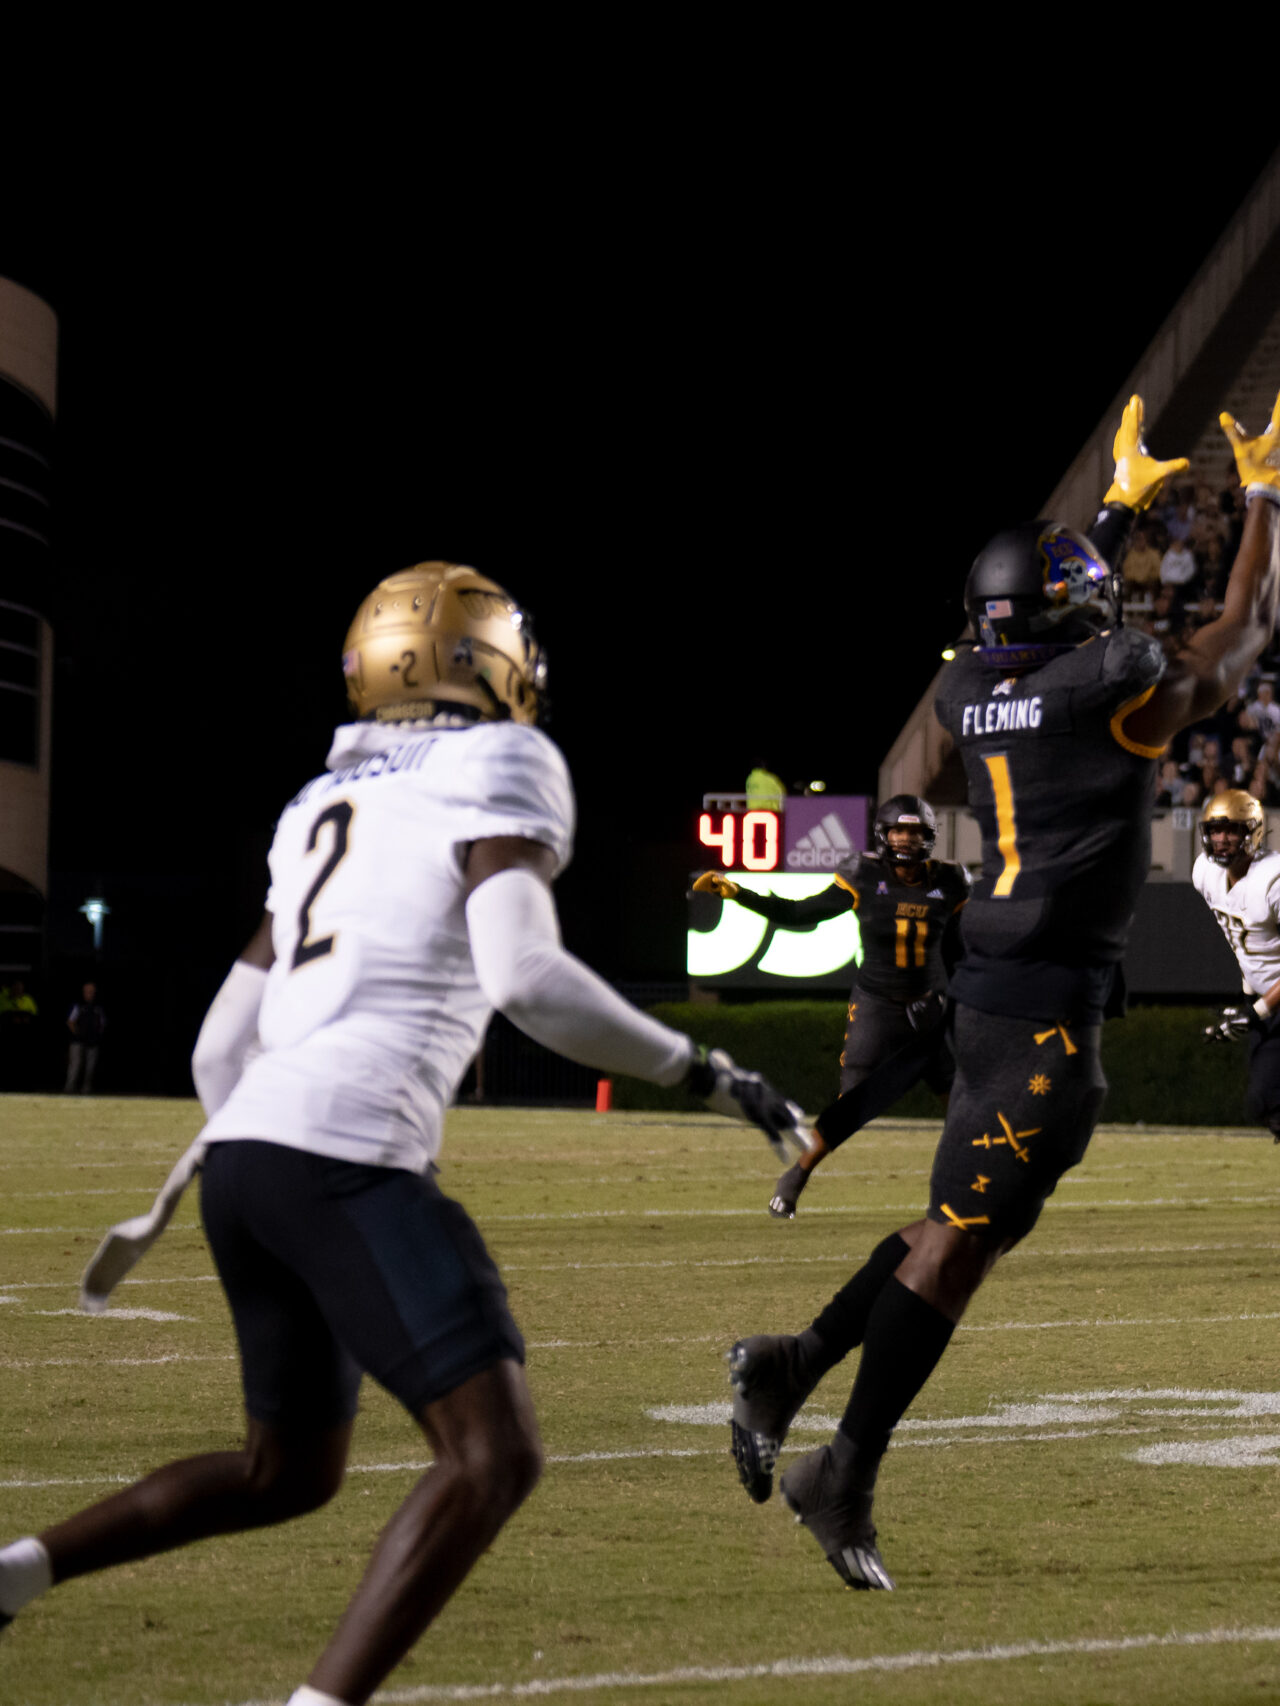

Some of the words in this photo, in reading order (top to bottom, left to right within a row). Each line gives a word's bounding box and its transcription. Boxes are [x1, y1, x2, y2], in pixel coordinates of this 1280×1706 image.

[401, 650, 419, 688] 2
[961, 695, 1043, 737] FLEMING
[698, 811, 779, 871] 40
[982, 753, 1023, 899] 1
[787, 846, 850, 868] adida
[288, 795, 357, 974] 2
[894, 918, 929, 968] 11
